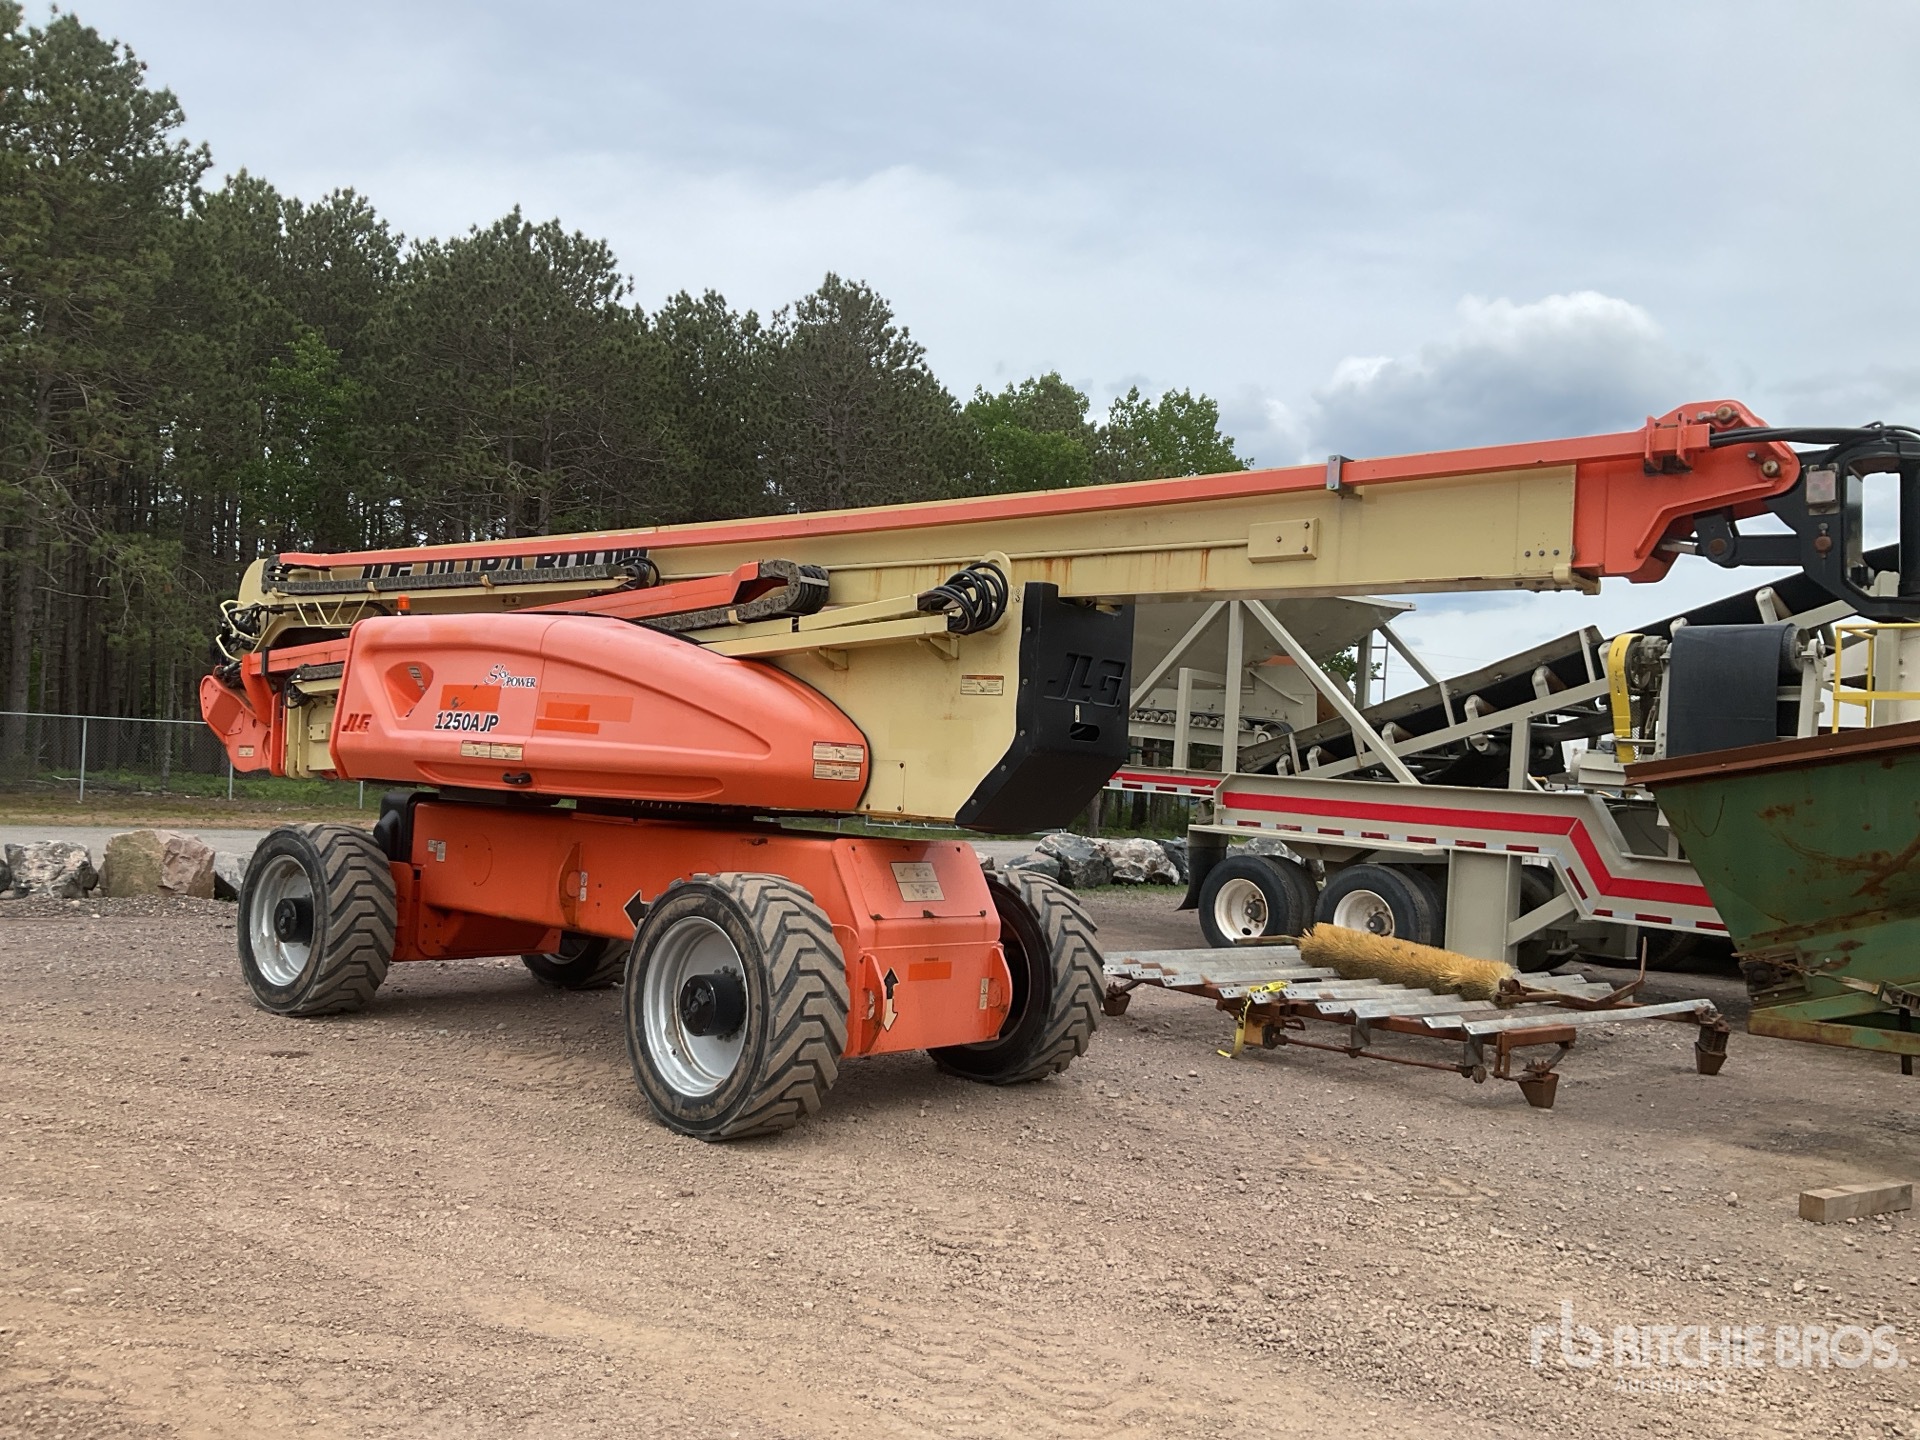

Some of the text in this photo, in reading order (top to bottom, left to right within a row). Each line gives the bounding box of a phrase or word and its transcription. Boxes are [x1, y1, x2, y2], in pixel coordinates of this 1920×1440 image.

[506, 676, 537, 688] POWER
[1043, 652, 1126, 708] JLG
[341, 713, 372, 733] JLG
[434, 711, 500, 733] 1250AJP
